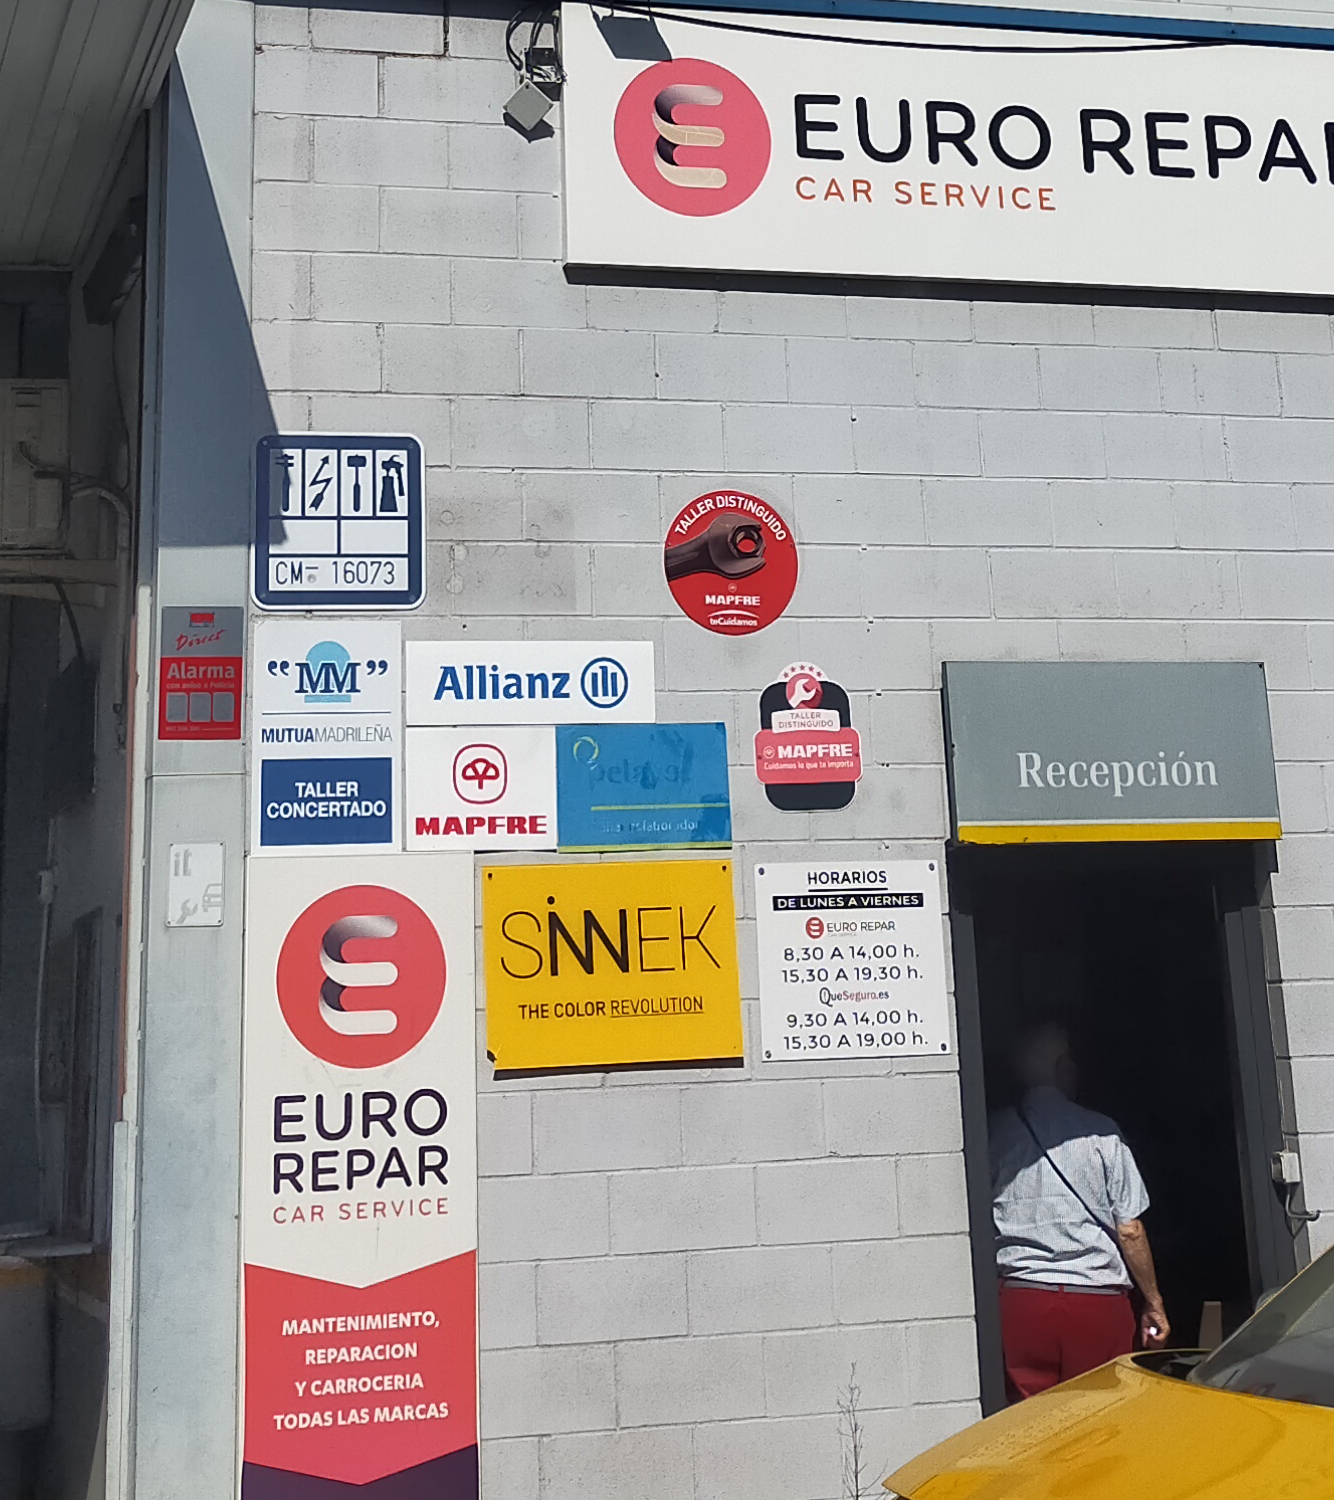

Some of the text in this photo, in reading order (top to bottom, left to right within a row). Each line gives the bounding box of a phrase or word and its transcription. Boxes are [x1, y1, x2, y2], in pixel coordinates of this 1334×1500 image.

[794, 93, 1052, 171] EURO
[795, 176, 1057, 212] CAR SERVICE
[674, 496, 786, 541] TALLER DISTINGUIDO
[332, 561, 395, 585] 16073
[705, 595, 760, 605] MAPFRE
[167, 662, 235, 679] Alarma
[434, 664, 570, 701] Allianz
[779, 720, 834, 728] DISTINGUIDO
[261, 725, 393, 744] MUTUAMADRILEÑA
[778, 744, 852, 758] MAPFRE
[764, 762, 796, 770] Cuidamos
[806, 762, 817, 770] que
[1017, 751, 1218, 797] Recepción
[295, 781, 358, 798] TALLER
[266, 801, 386, 818] CONCERTADO
[415, 815, 547, 836] MAPFRE
[807, 871, 887, 885] HORARIOS
[777, 895, 918, 908] DE LUNES A VIERNES
[827, 921, 895, 932] EURO REPAR
[784, 944, 919, 962] 8,30 A 14,00 h.
[781, 966, 923, 983] 15,30 A 19,30 h.
[519, 996, 703, 1019] THE COLOR REVOLUTION
[787, 1010, 923, 1029] 9,30 A 14,00 h.
[783, 1031, 928, 1050] 15,30 A 19,00 h.
[274, 1089, 448, 1143] EURO
[272, 1144, 448, 1195] REPAR
[272, 1197, 449, 1224] CAR SERVICE
[282, 1312, 441, 1336] MANTENIMIENTO,
[305, 1342, 418, 1365] REPARACION
[295, 1373, 424, 1397] Y CARROCERIA
[274, 1402, 449, 1431] TODAS LAS MARCAS
